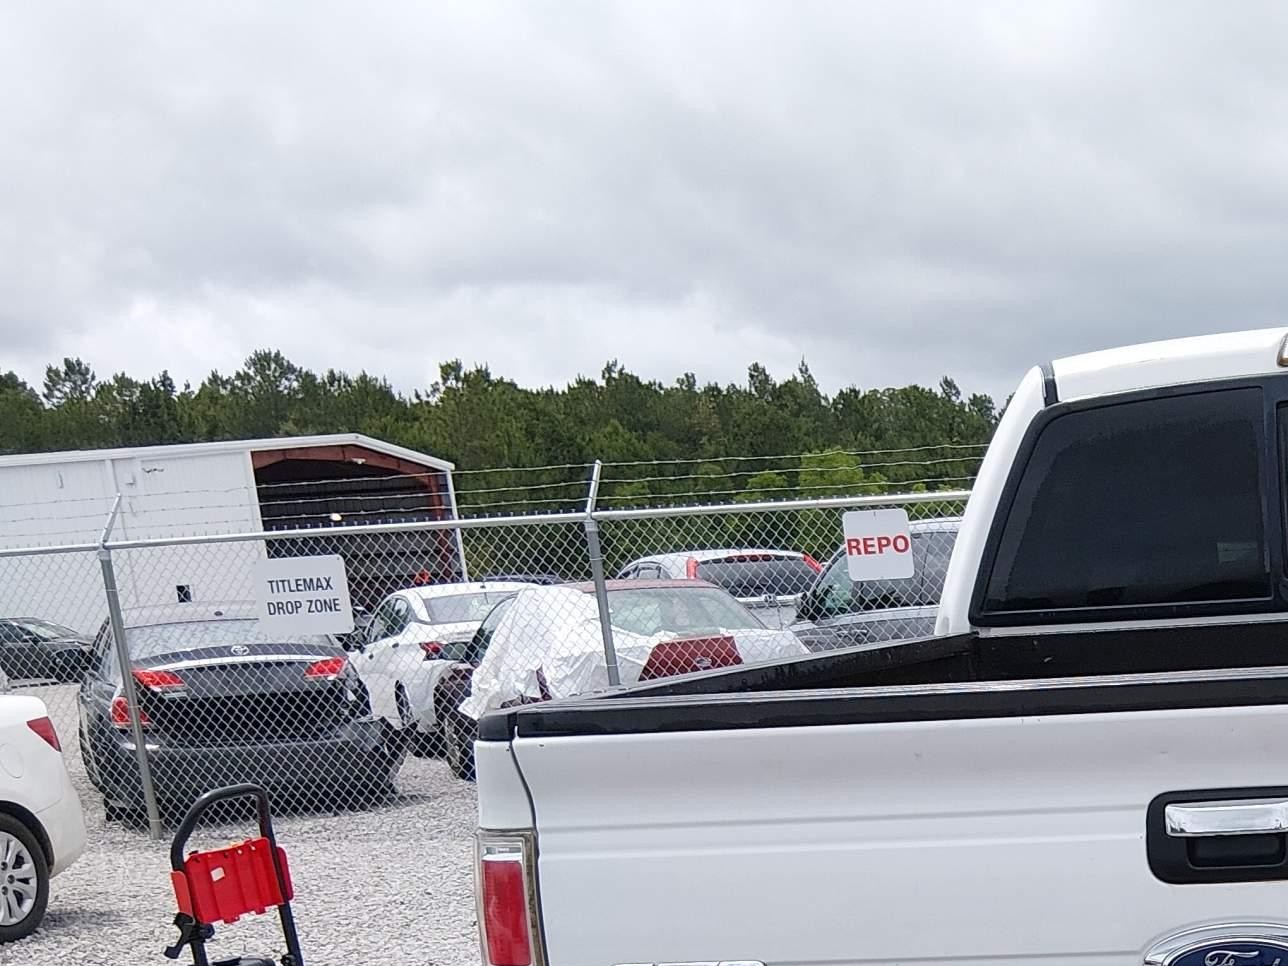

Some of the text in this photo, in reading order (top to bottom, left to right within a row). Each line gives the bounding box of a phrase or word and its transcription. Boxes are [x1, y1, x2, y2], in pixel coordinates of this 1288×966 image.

[847, 535, 909, 556] REPO
[267, 576, 333, 594] TITLEMAX
[267, 598, 341, 615] DROP ZONE
